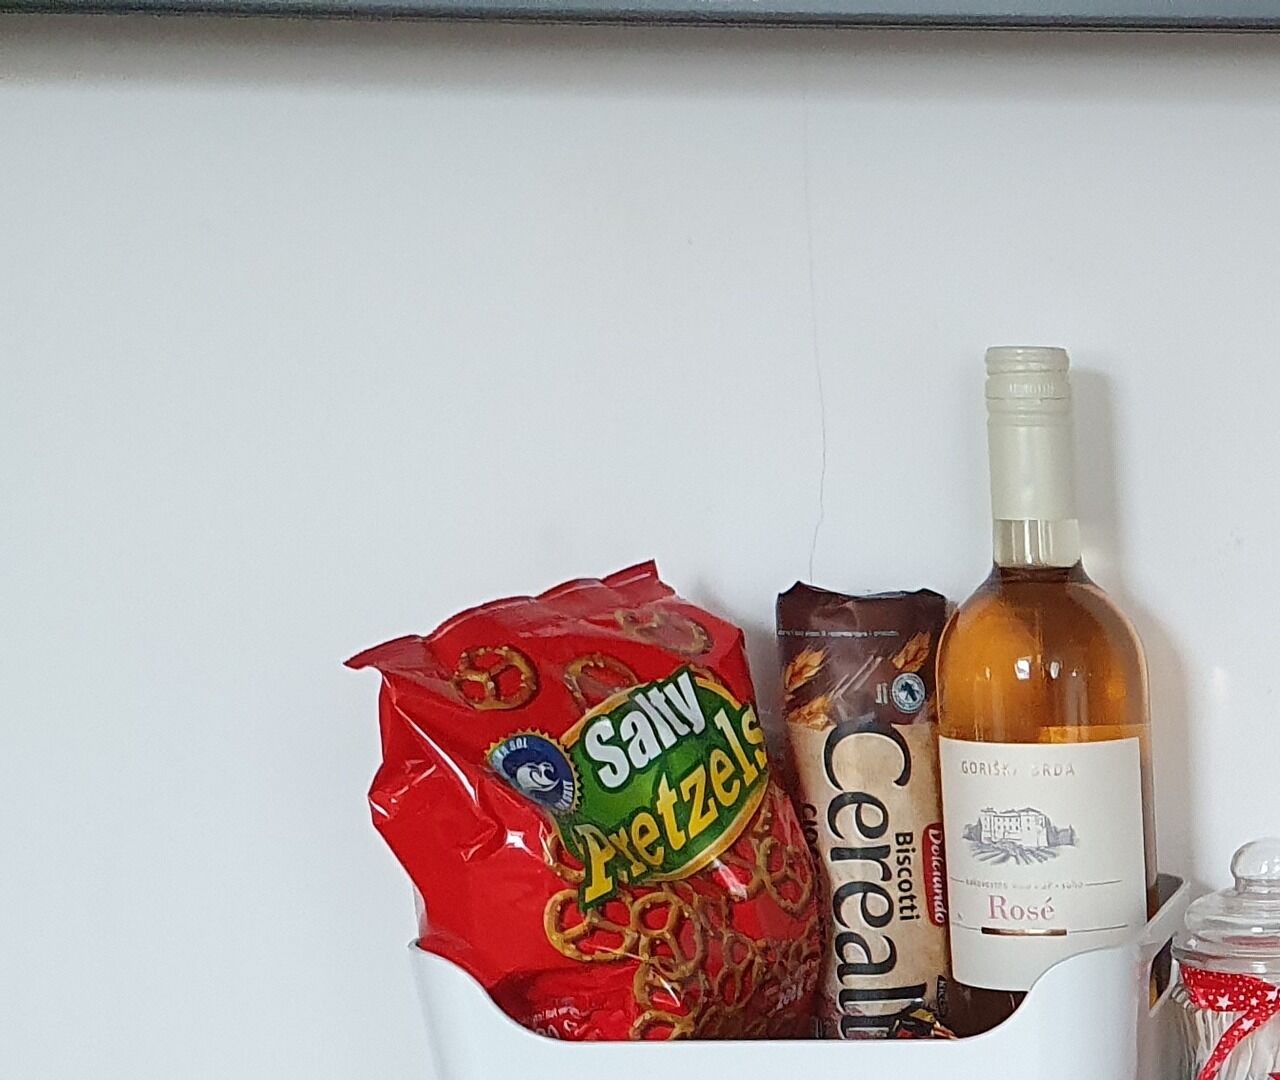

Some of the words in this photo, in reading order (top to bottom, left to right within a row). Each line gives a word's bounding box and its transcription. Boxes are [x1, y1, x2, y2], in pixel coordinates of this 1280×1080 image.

[584, 671, 706, 789] Salty
[573, 704, 768, 903] Pretzels
[895, 831, 920, 921] Biscotti
[928, 828, 947, 924] Dolciando
[987, 894, 1056, 921] Rosé
